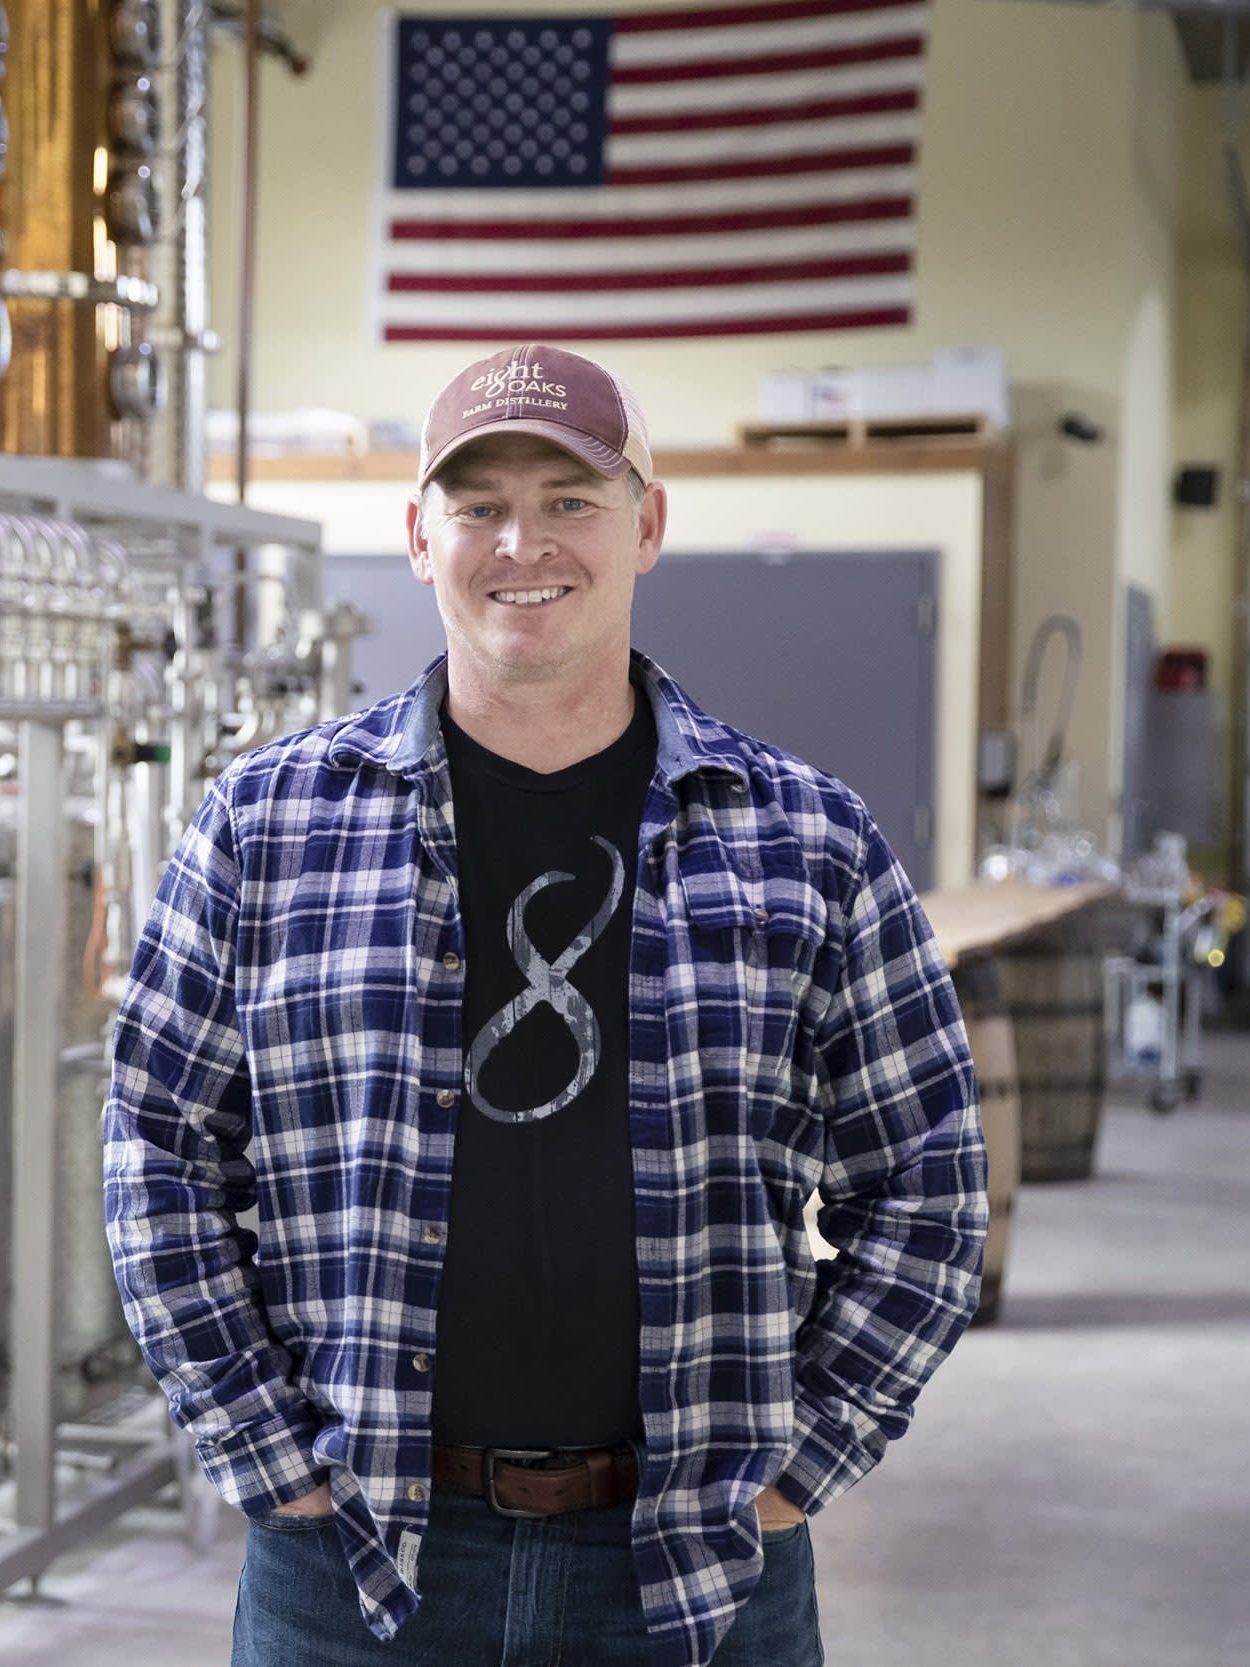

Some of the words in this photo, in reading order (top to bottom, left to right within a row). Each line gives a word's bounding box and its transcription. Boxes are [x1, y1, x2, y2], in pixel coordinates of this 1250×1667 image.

[471, 361, 543, 398] eight
[508, 380, 566, 397] OAKS
[462, 401, 492, 419] FARM
[495, 397, 567, 410] DISTILLERY
[464, 834, 625, 1123] 8
